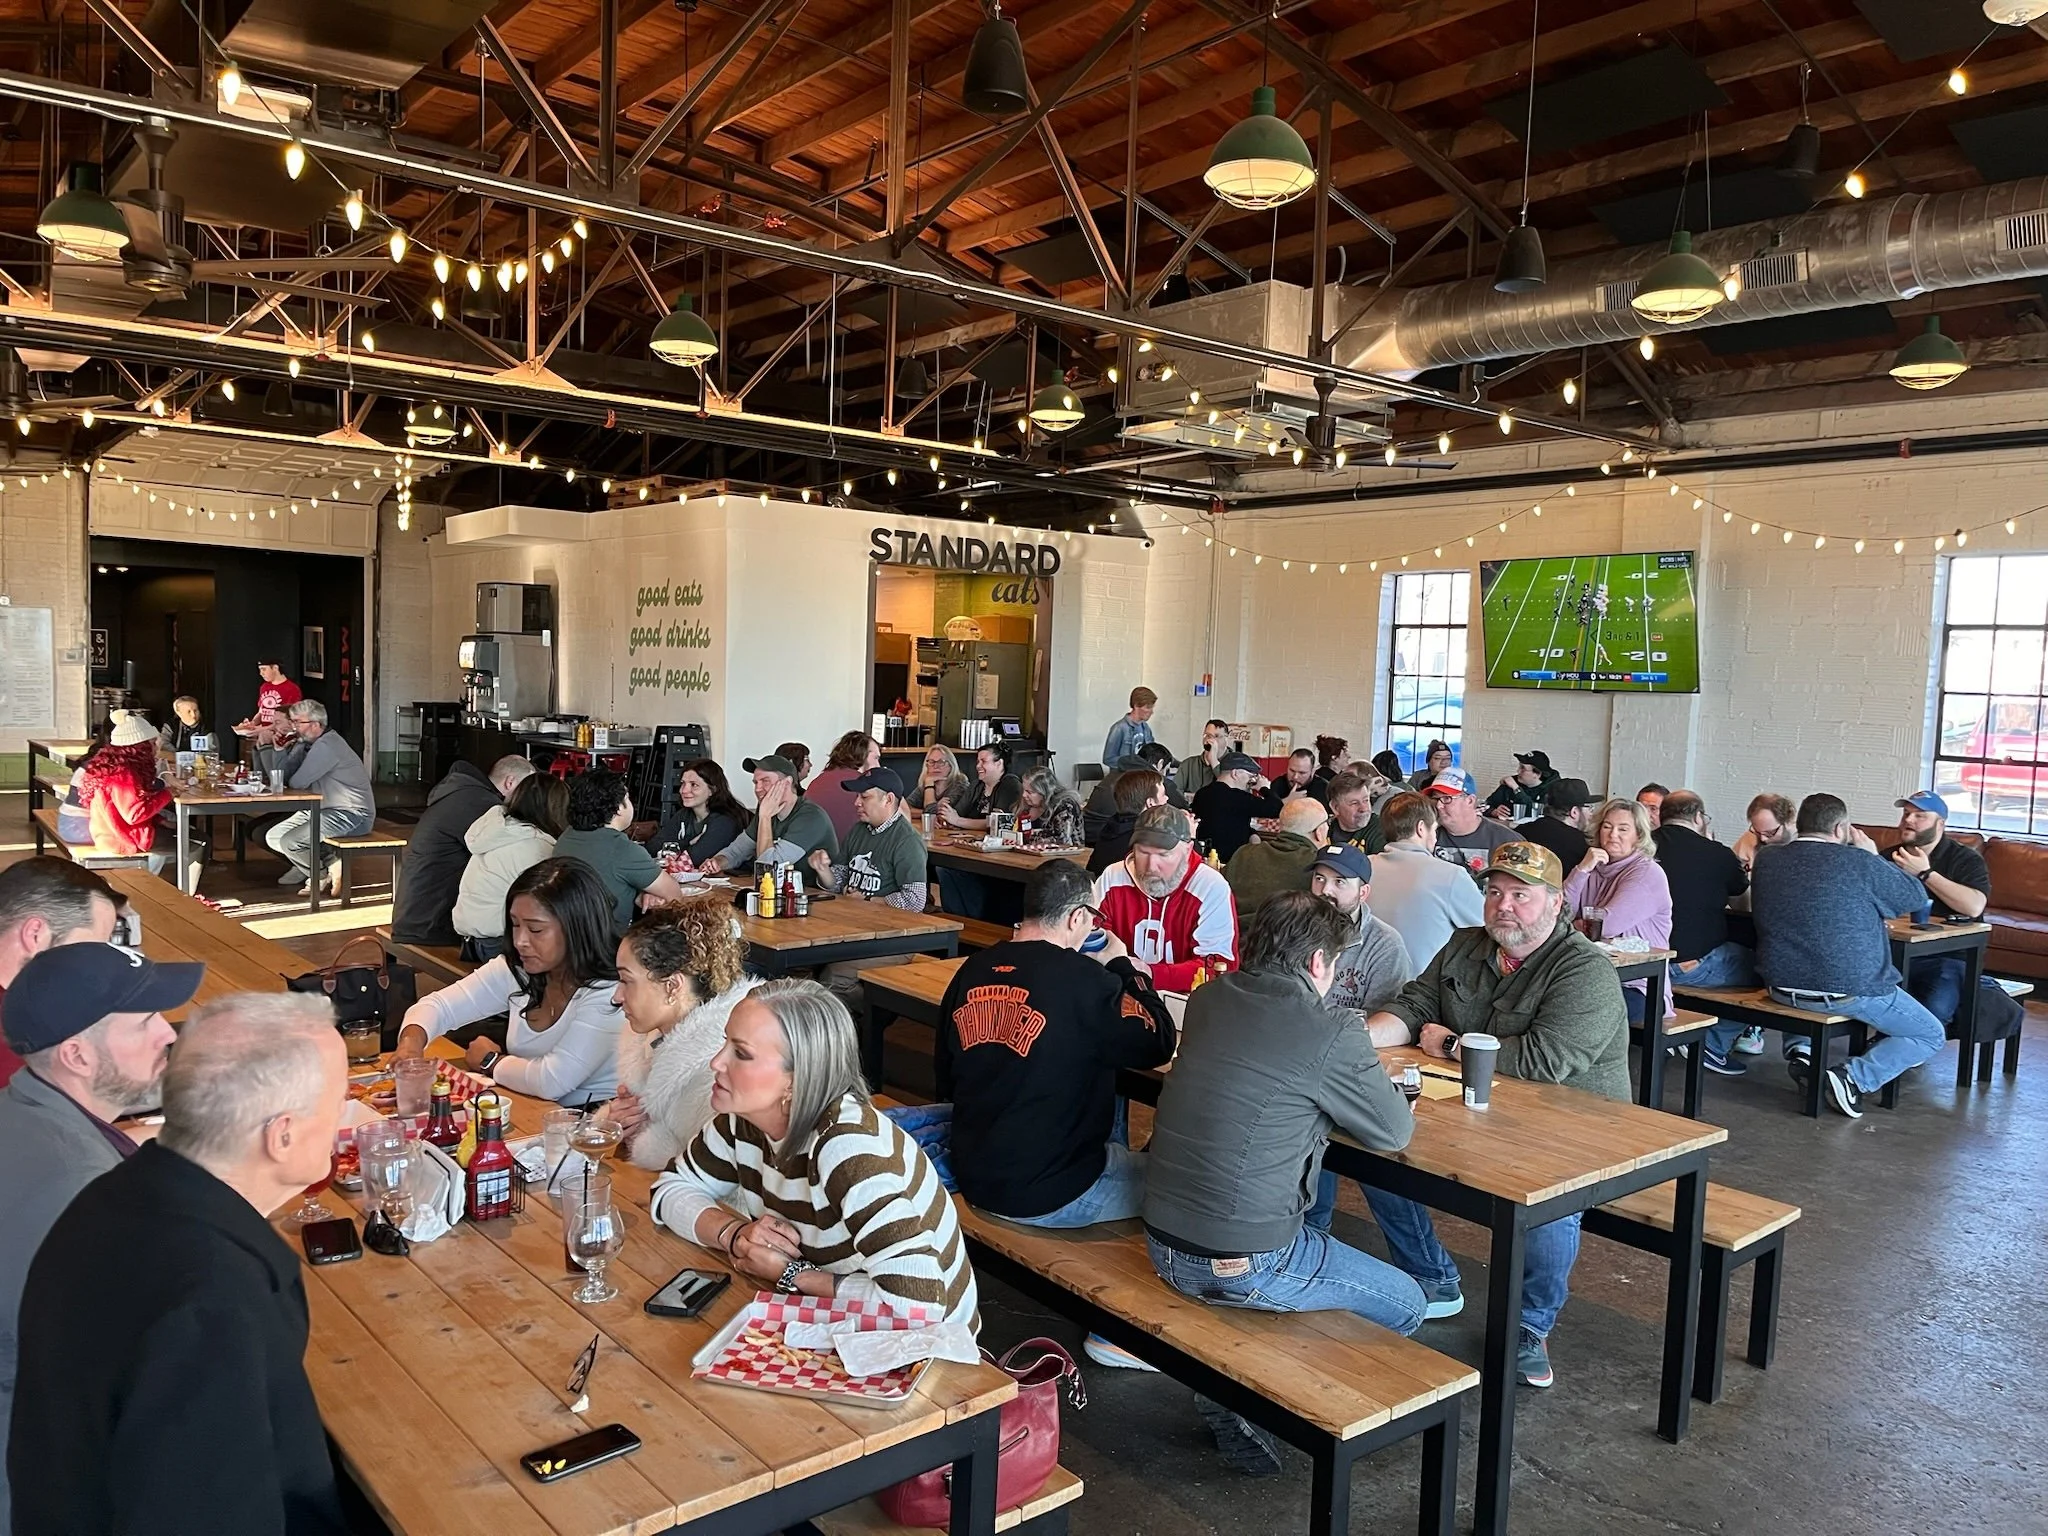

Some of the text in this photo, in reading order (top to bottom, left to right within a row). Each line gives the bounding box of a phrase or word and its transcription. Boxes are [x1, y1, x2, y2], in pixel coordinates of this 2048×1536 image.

[869, 527, 1061, 577] STANDARD
[636, 577, 704, 617] good eats
[991, 575, 1042, 605] eats
[629, 618, 711, 656] good drinks
[629, 659, 711, 698] good people
[194, 737, 206, 748] 71
[967, 985, 1030, 1003] OKLAHOMA CITY
[952, 998, 1047, 1058] THUNDER
